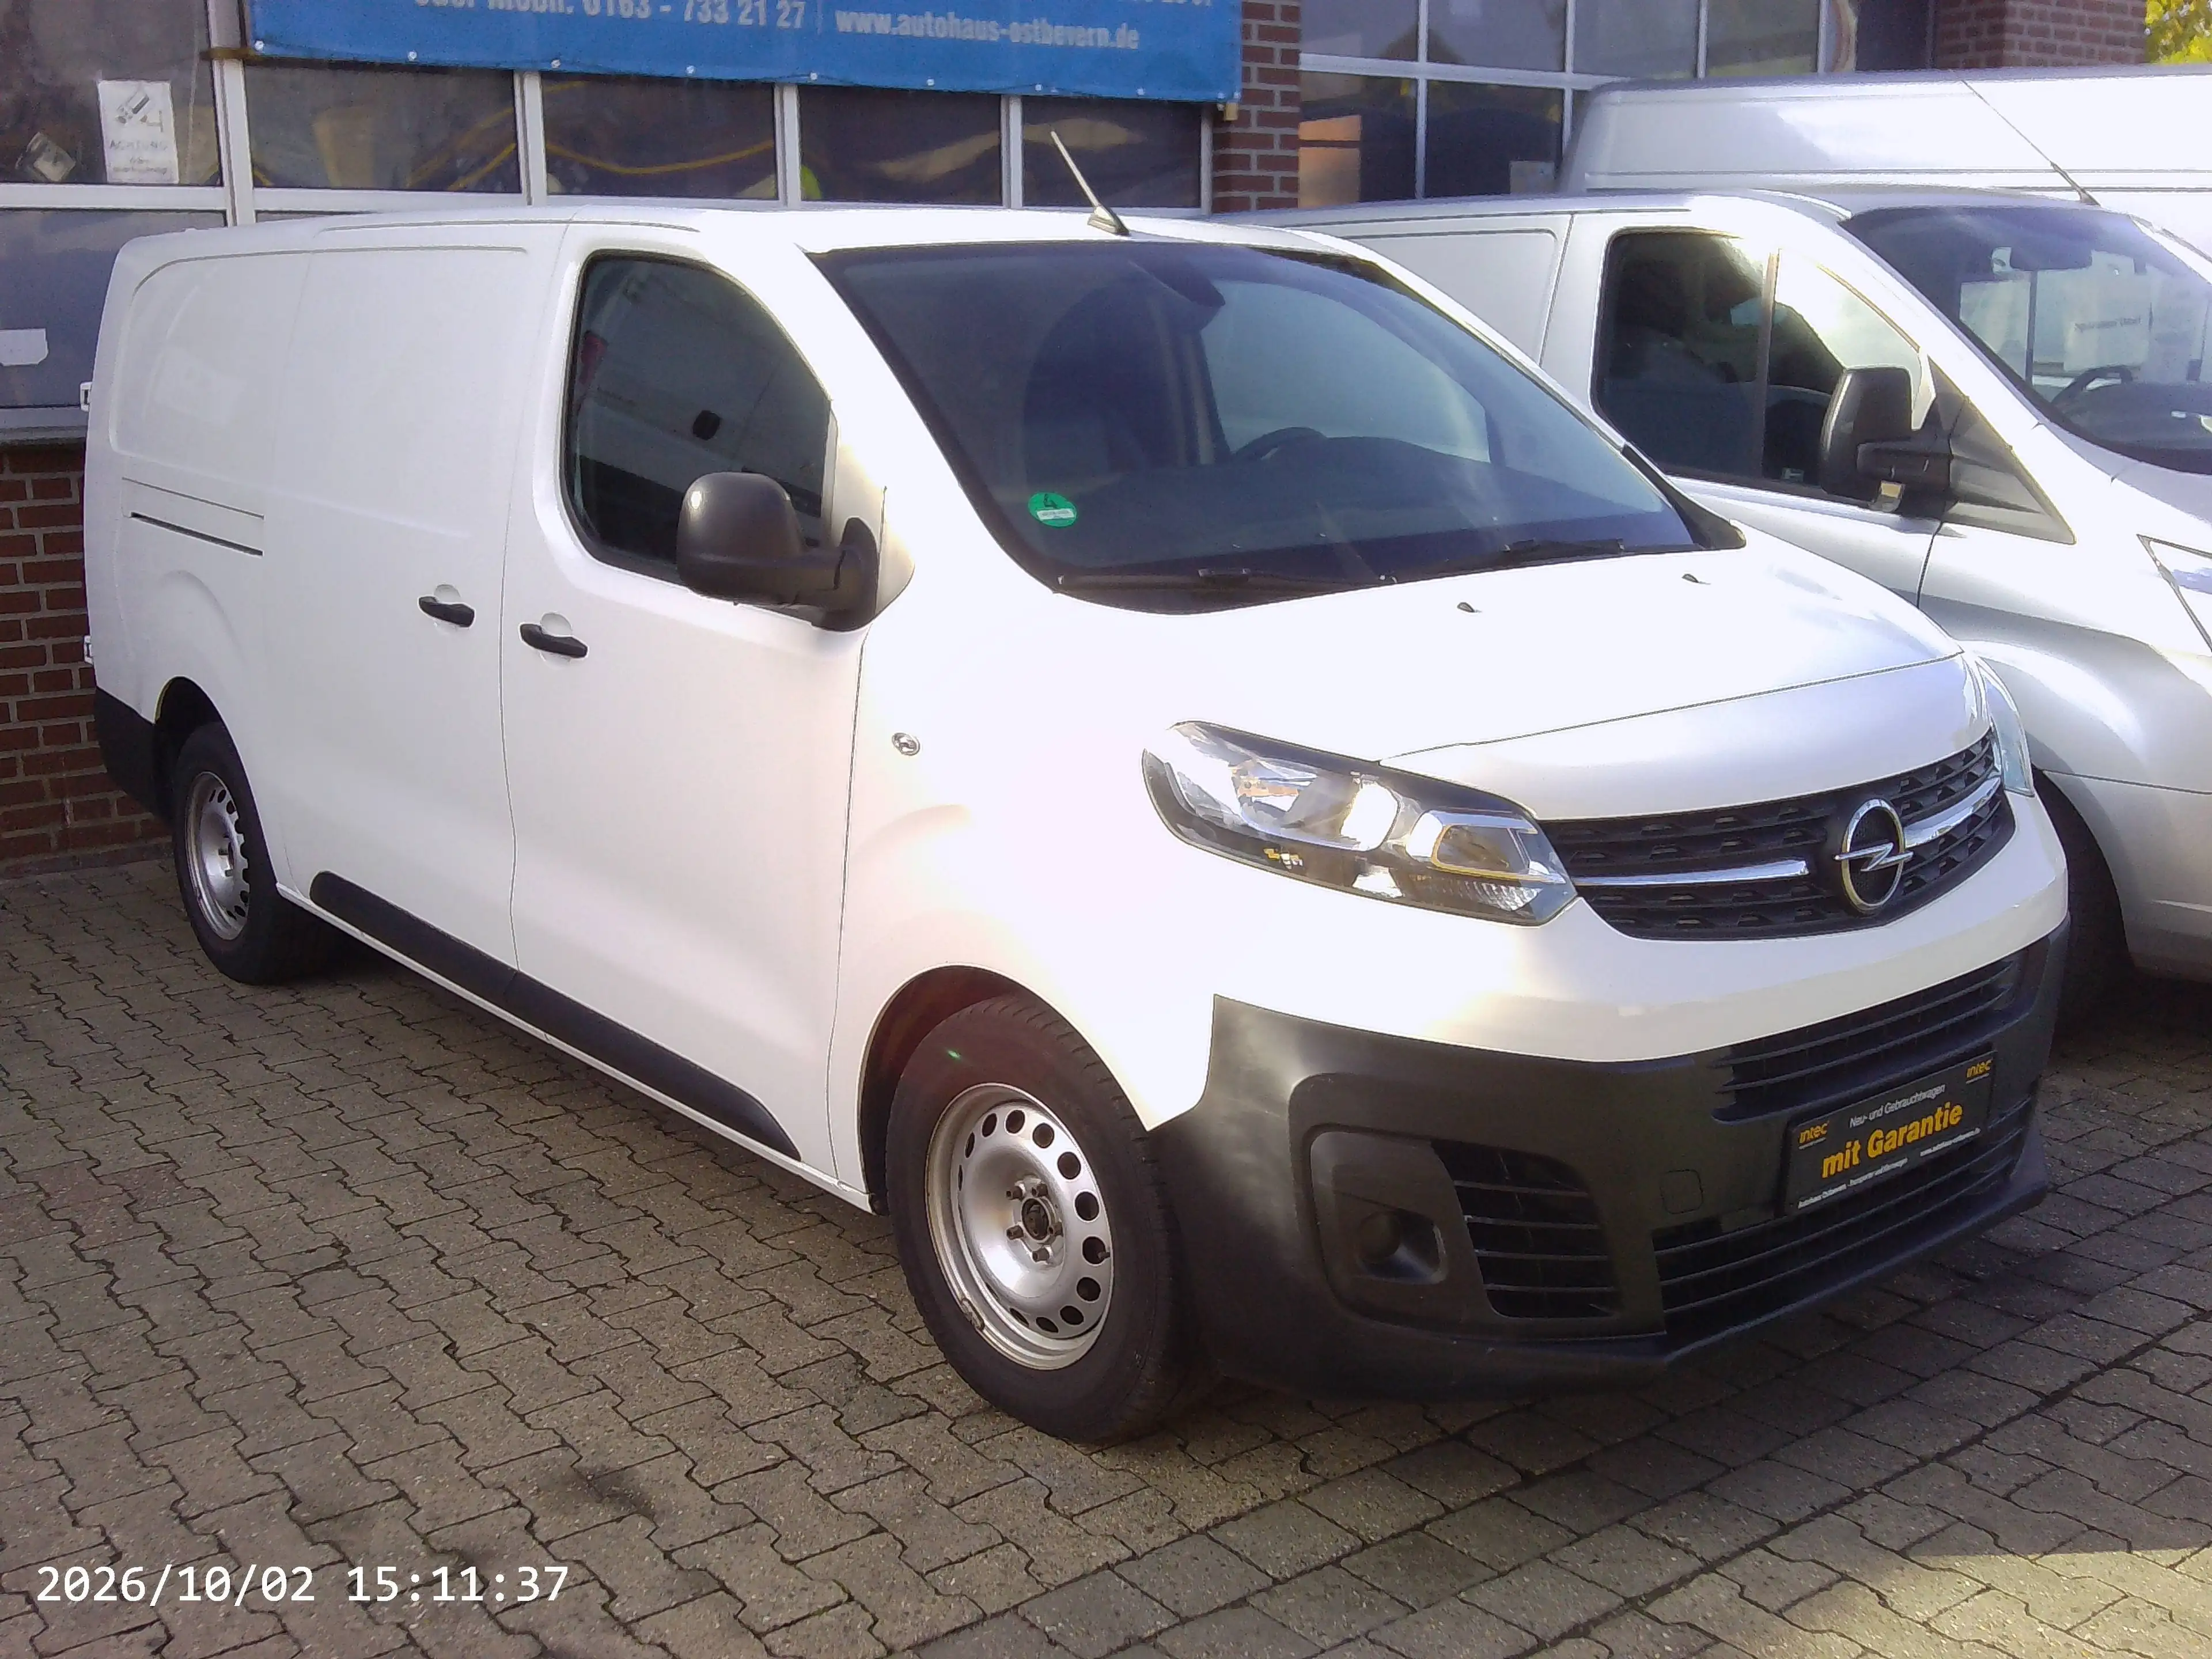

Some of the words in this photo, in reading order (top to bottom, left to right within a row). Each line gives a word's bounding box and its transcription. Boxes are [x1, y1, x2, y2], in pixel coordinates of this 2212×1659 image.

[582, 0, 651, 18] 0163
[684, 0, 729, 24] 733
[737, 0, 767, 26] 21
[776, 1, 805, 29] 27
[1869, 1105, 1884, 1121] und
[1821, 1140, 1861, 1179] mit
[1867, 1101, 1963, 1158] Garantie
